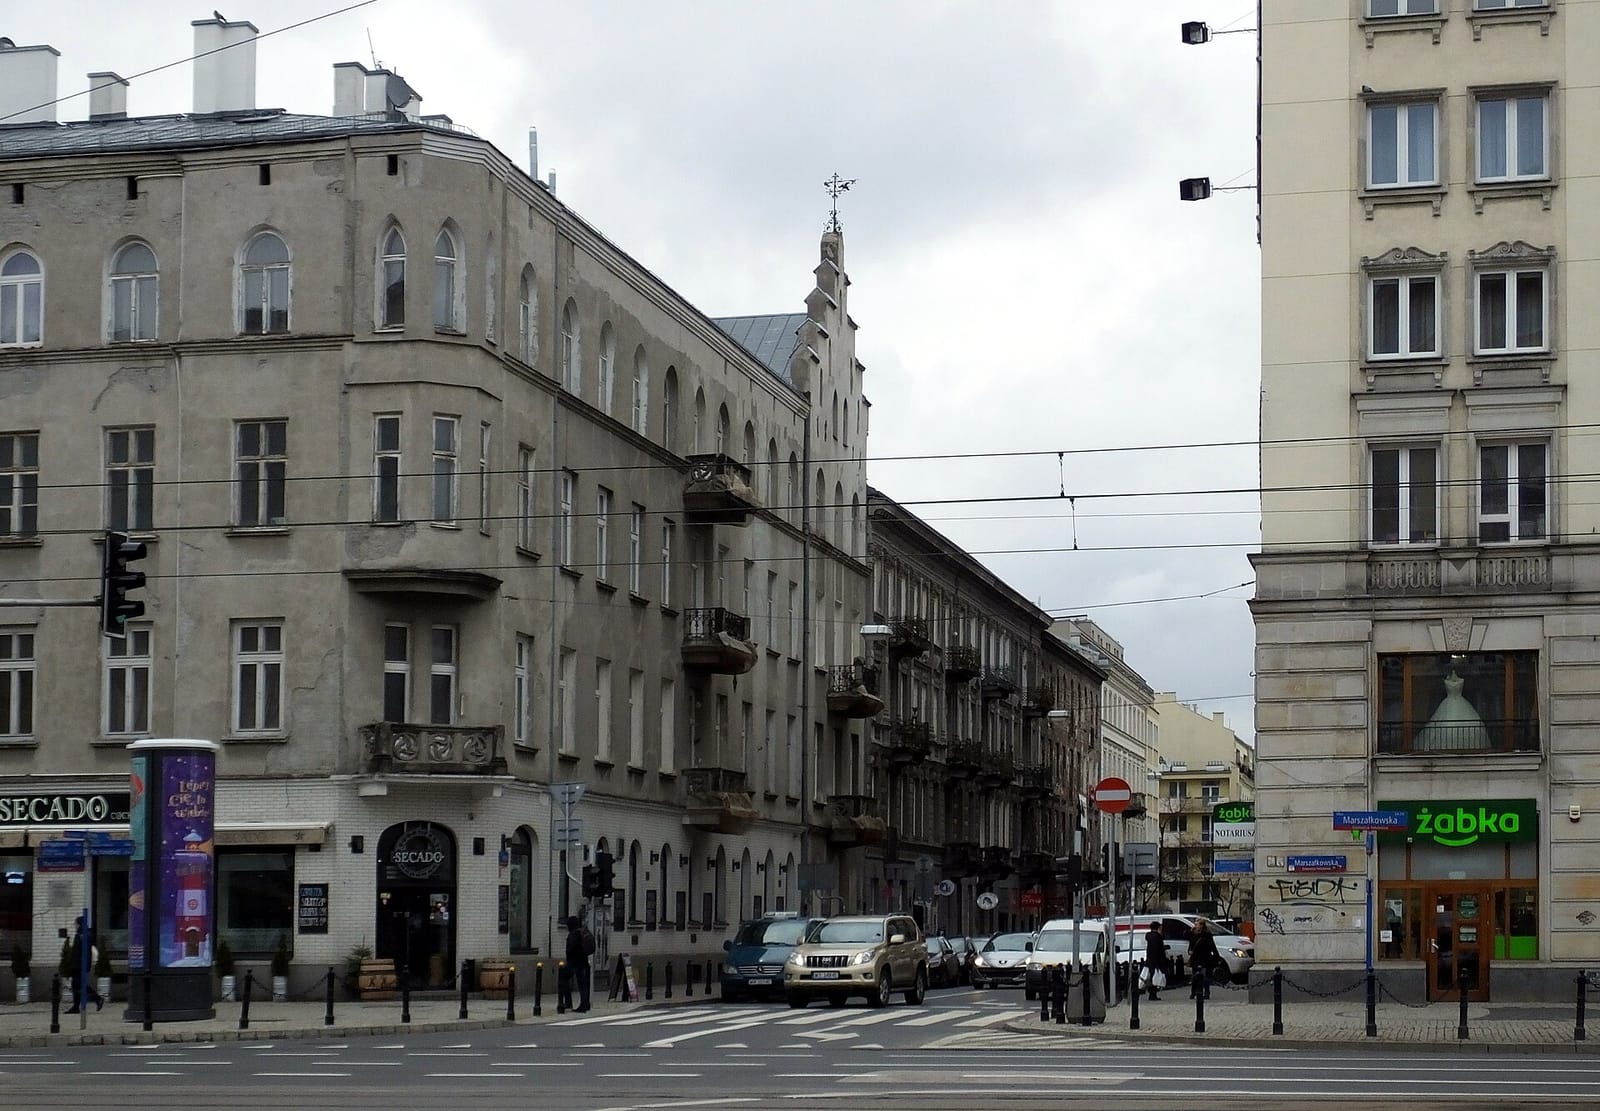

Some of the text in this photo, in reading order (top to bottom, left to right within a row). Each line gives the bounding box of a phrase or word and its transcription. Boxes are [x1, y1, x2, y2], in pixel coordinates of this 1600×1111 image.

[0, 795, 109, 822] SECADO
[1416, 807, 1520, 834] żabka
[394, 851, 443, 863] SECADO
